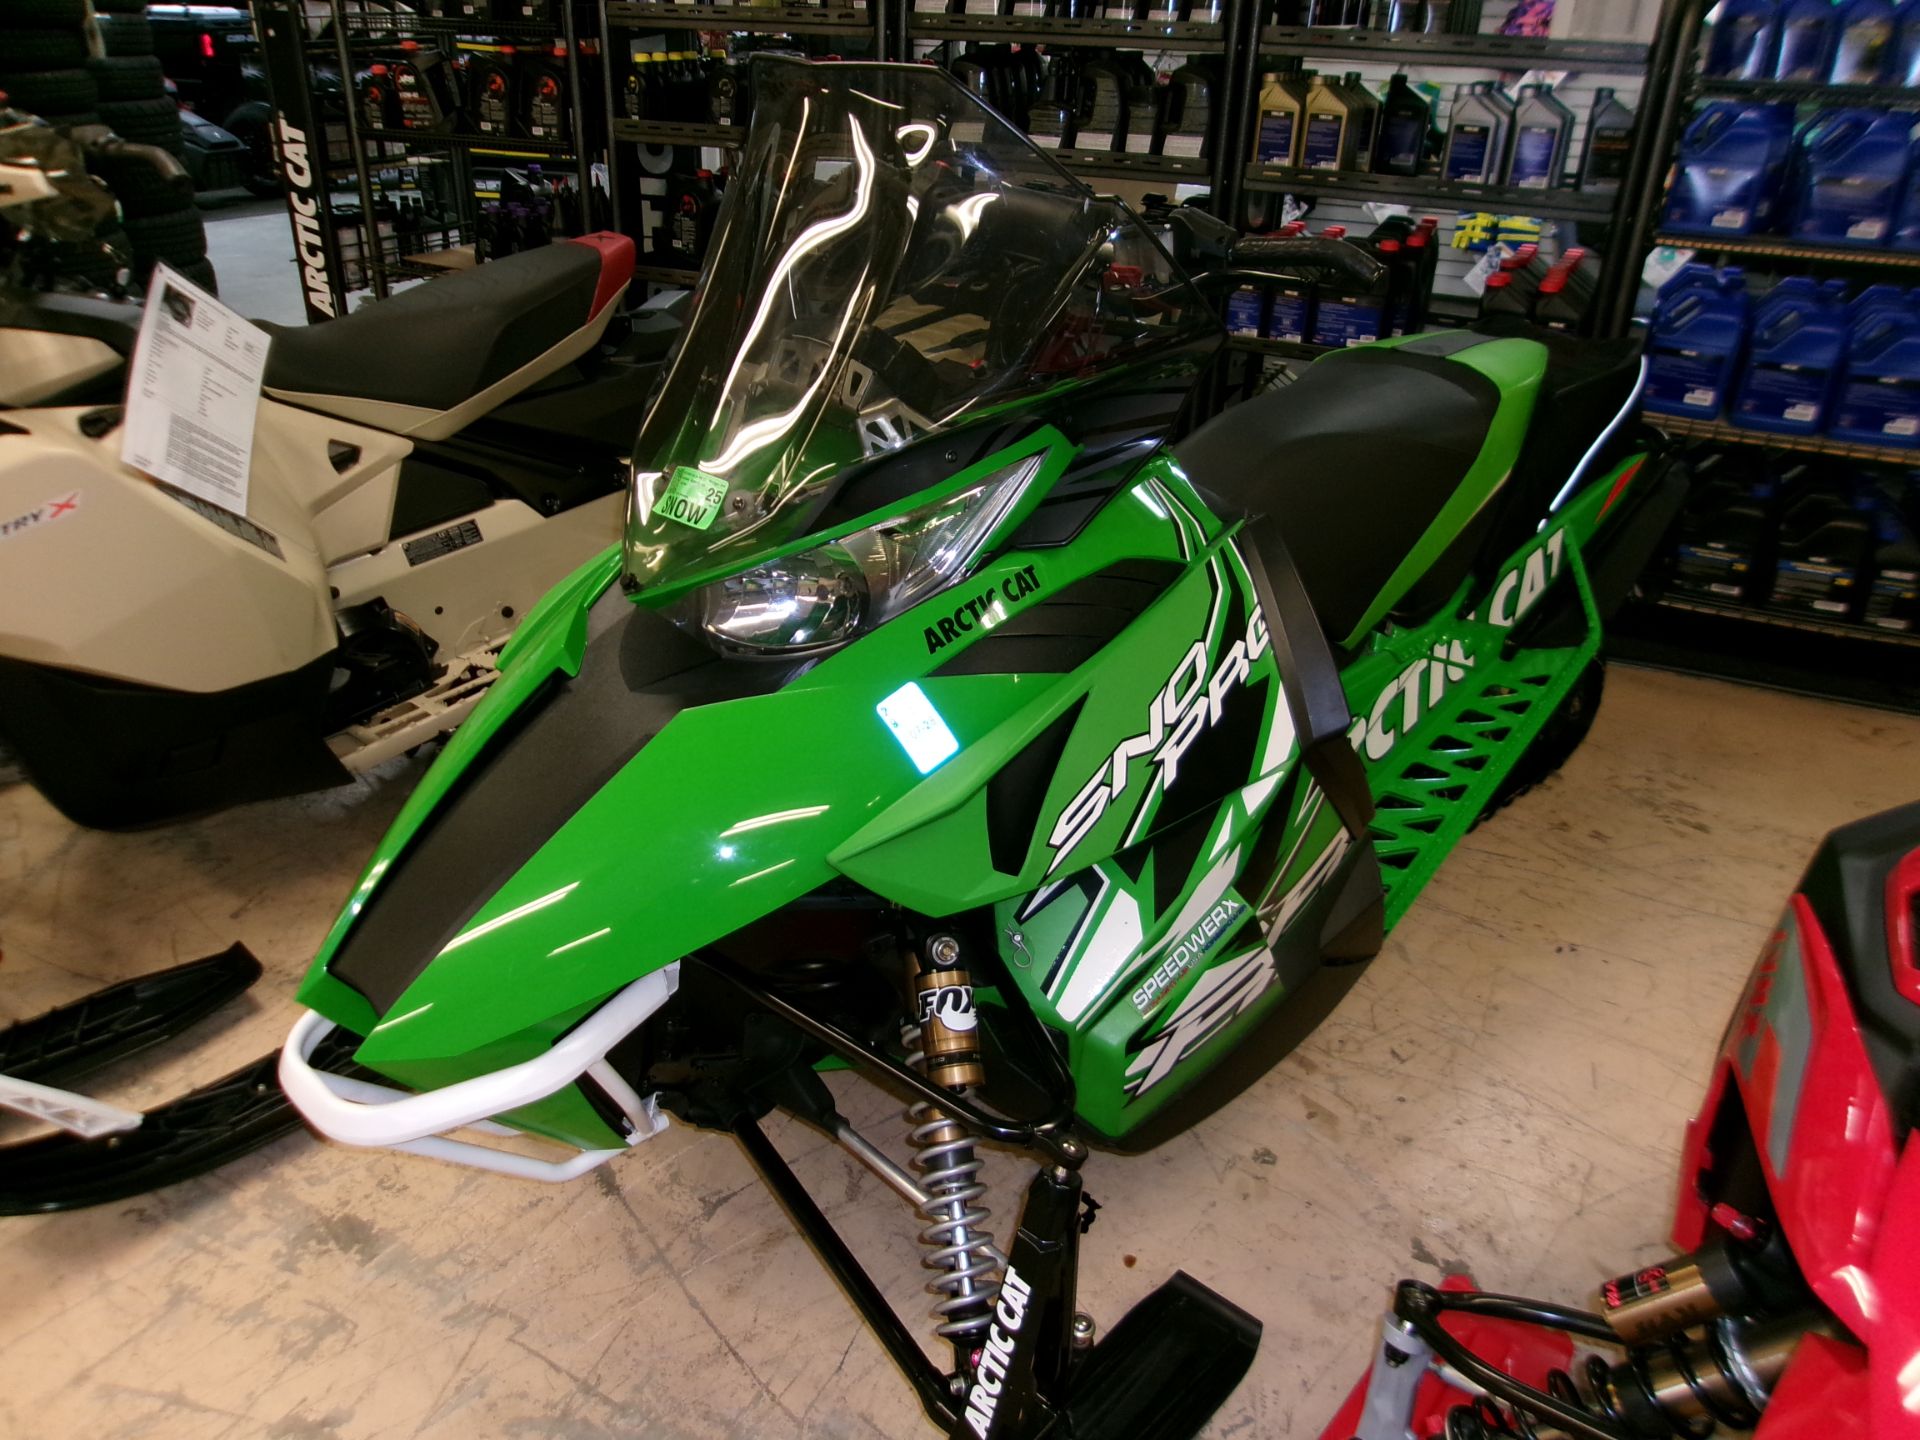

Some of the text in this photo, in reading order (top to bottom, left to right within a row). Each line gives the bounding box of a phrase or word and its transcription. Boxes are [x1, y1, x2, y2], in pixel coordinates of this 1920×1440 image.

[279, 117, 335, 318] ARCTIC CAT
[661, 495, 708, 526] SNOW
[705, 487, 723, 505] 25
[923, 564, 1041, 655] ARCTIC CAT
[1489, 528, 1564, 627] CAT
[1046, 640, 1207, 877] SNO
[1132, 899, 1240, 1011] SPEEDWERX
[918, 985, 978, 1031] FOX
[964, 1265, 1031, 1440] ARCTIC CAT
